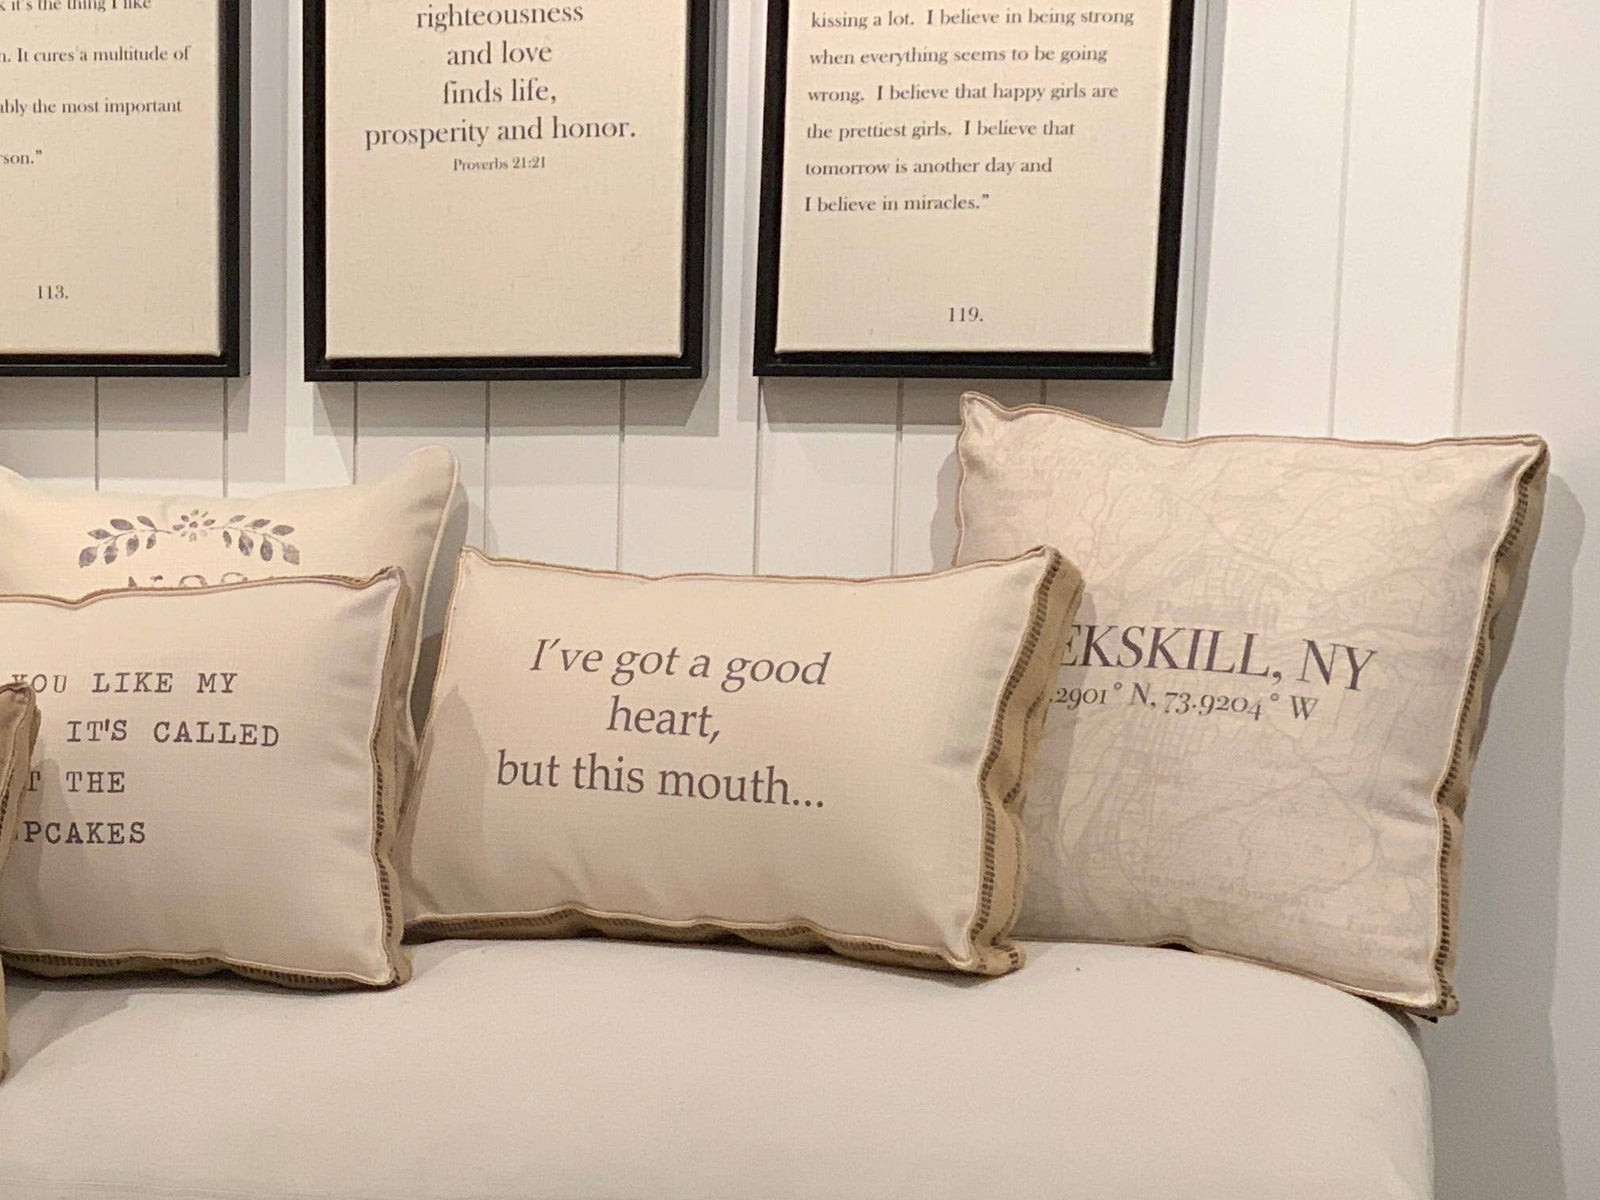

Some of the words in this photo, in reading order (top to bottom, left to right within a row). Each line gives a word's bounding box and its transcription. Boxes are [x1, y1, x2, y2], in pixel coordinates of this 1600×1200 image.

[416, 2, 584, 33] righteousness
[811, 11, 869, 31] kissing
[872, 15, 883, 27] a
[888, 9, 915, 27] lot.
[925, 8, 935, 26] I
[940, 7, 1000, 25] believe
[1005, 7, 1022, 25] in
[1028, 7, 1077, 27] being
[1080, 10, 1135, 27] strong
[16, 47, 29, 63] It
[33, 51, 75, 63] cures
[79, 50, 89, 62] a
[93, 44, 169, 62] multitude
[172, 44, 192, 61] of
[446, 40, 493, 66] and
[501, 39, 553, 64] love
[809, 48, 856, 65] when
[859, 46, 949, 67] everything
[953, 50, 1007, 62] seems
[1011, 48, 1030, 62] to
[1034, 44, 1056, 62] be
[1059, 44, 1108, 65] going
[443, 79, 503, 105] finds
[511, 76, 557, 105] life,
[32, 98, 57, 114] the
[61, 100, 99, 114] most
[104, 96, 183, 117] important
[364, 118, 490, 152] prosperity
[497, 115, 543, 142] and
[551, 114, 636, 140] honor.
[806, 122, 833, 139] the
[838, 124, 907, 143] prettiest
[911, 119, 953, 141] girls.
[963, 119, 972, 136] I
[976, 119, 1038, 136] believe
[1042, 119, 1076, 136] that
[453, 156, 509, 172] Proverbs
[512, 155, 546, 170] 21:21
[805, 163, 890, 176] tomorrow
[895, 159, 908, 174] is
[912, 156, 981, 174] another
[984, 156, 1016, 176] day
[1020, 156, 1053, 173] and
[803, 196, 813, 213] I
[817, 195, 877, 213] believe
[882, 195, 899, 211] in
[37, 284, 69, 300] 113.
[948, 306, 984, 323] 119.
[529, 637, 604, 673] I've
[610, 646, 681, 687] got
[688, 654, 711, 679] a
[720, 651, 832, 694] good
[1296, 638, 1378, 693] NY
[90, 670, 175, 695] LIKE
[194, 671, 240, 696] MY
[1129, 683, 1157, 711] N,
[1164, 692, 1280, 721] 73.9204°
[1290, 695, 1320, 721] W
[605, 694, 721, 745] heart,
[66, 718, 128, 743] IT'S
[153, 720, 280, 748] CALLED
[65, 770, 126, 794] THE
[496, 748, 561, 788] but
[572, 751, 645, 794] this
[657, 764, 824, 809] mouth...
